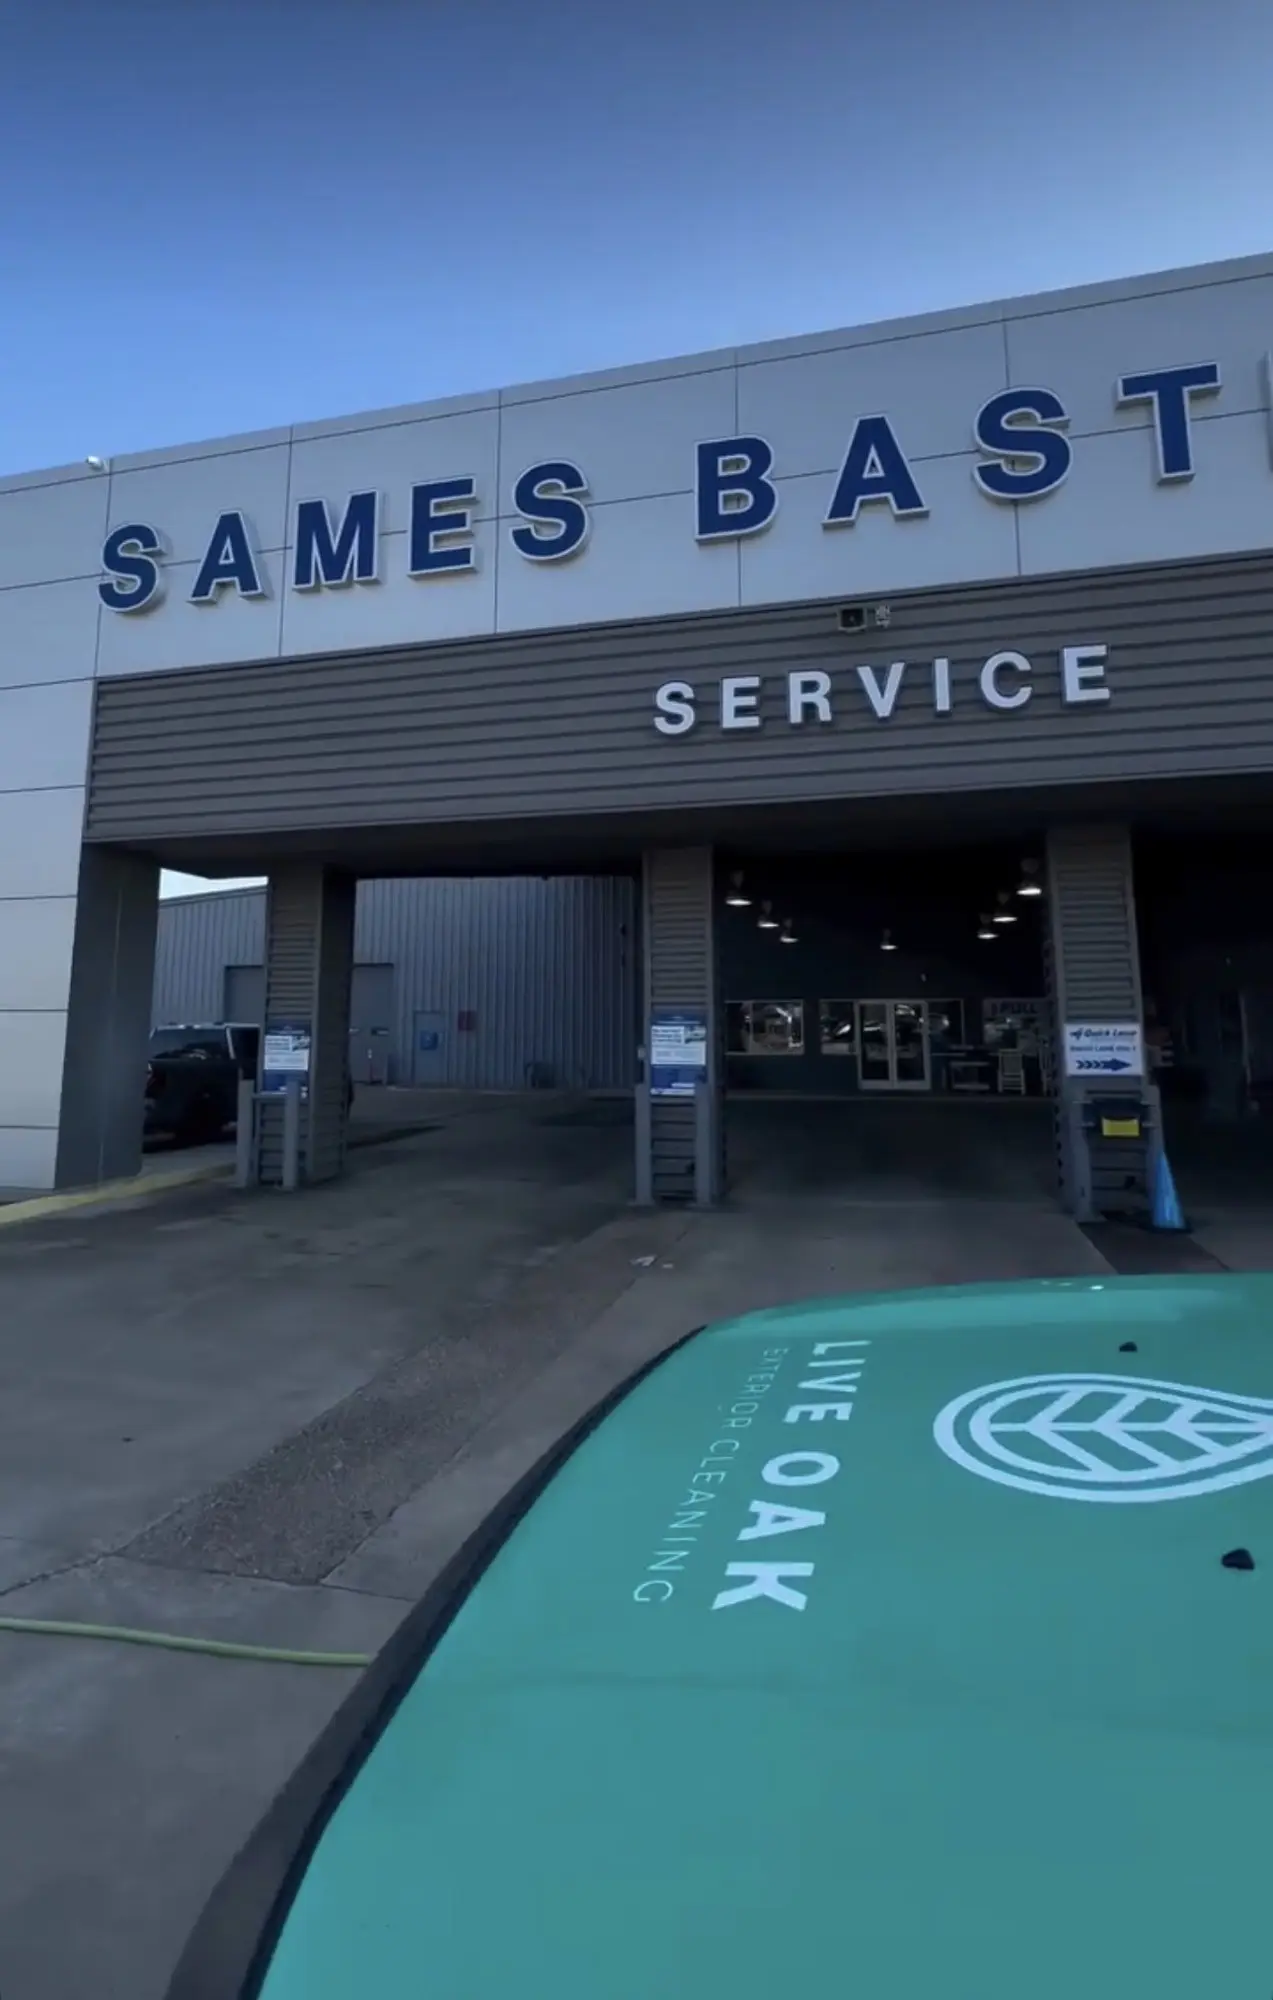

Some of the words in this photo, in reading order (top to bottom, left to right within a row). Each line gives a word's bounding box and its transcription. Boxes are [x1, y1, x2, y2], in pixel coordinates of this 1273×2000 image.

[97, 459, 590, 614] SAMES
[694, 350, 1273, 543] BAST
[653, 644, 1111, 736] SERVICE
[722, 1347, 790, 1429] EXTERIOR
[782, 1339, 872, 1424] LIVE
[633, 1438, 740, 1603] CLEANING
[711, 1450, 840, 1612] OAK
